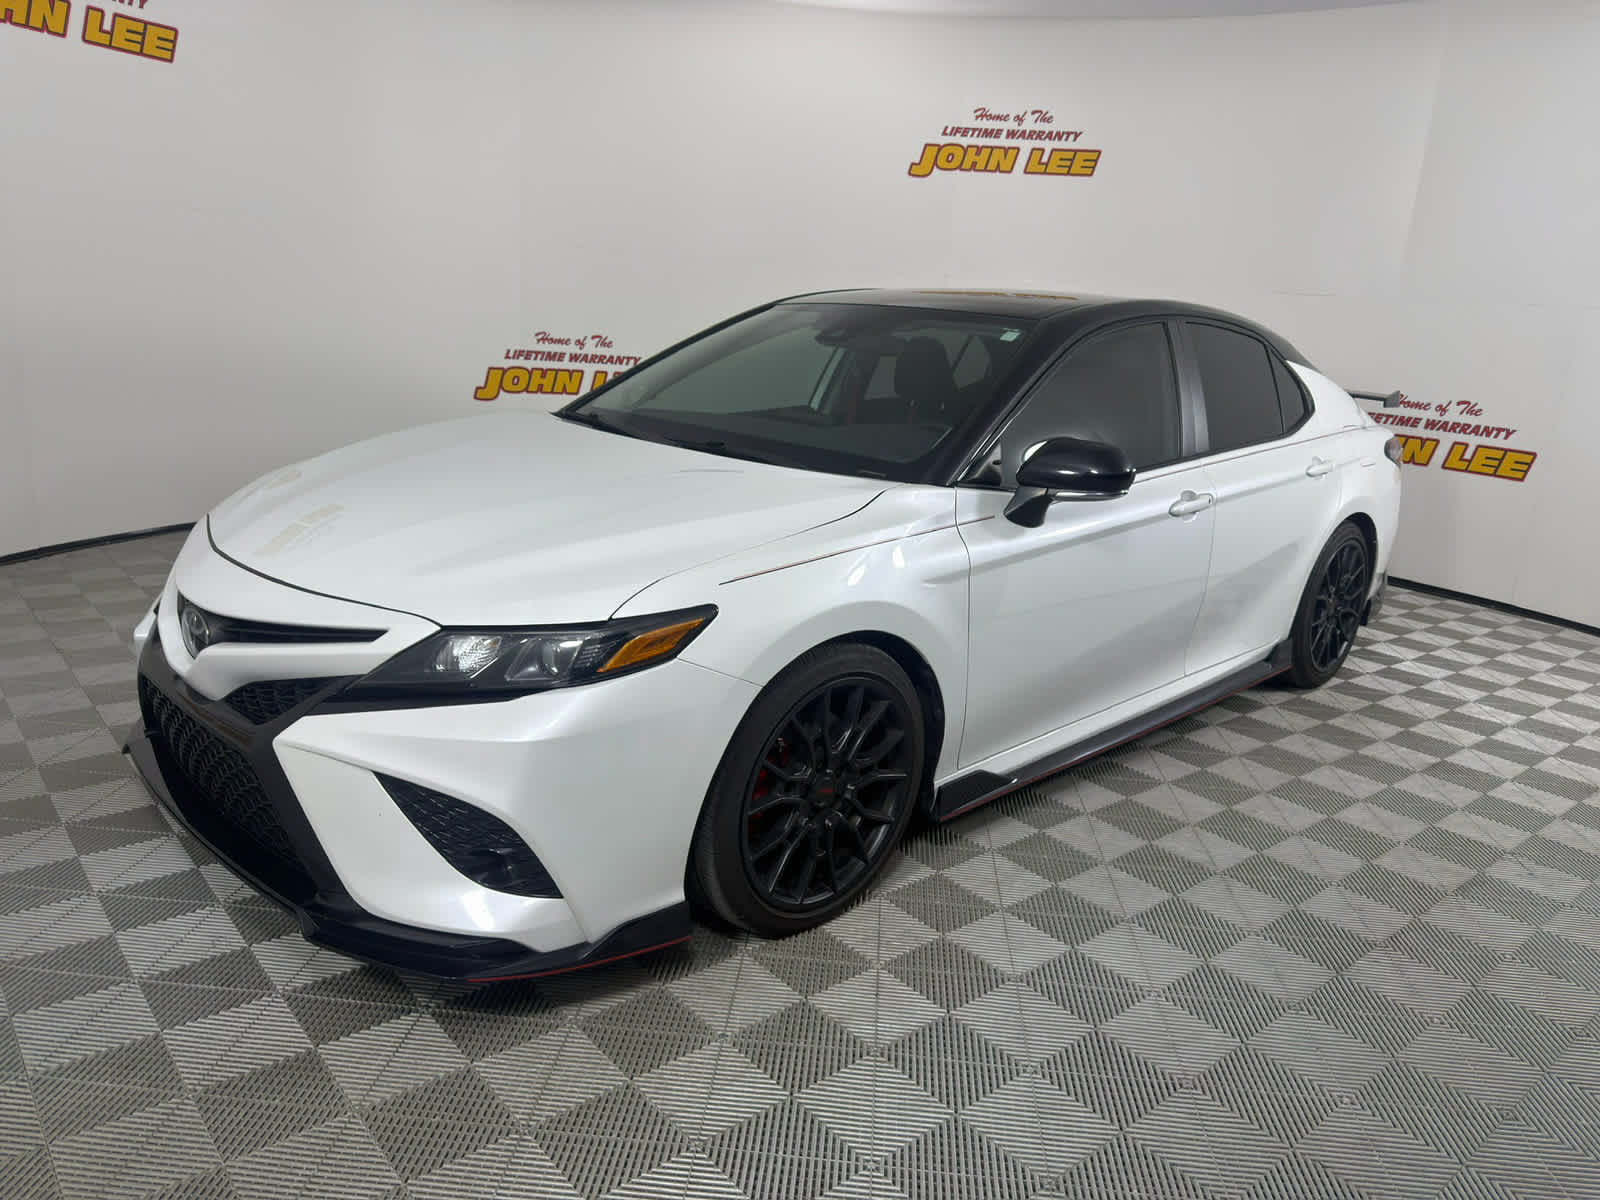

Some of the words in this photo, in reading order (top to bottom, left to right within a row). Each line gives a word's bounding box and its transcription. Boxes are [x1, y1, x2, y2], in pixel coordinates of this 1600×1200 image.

[82, 5, 179, 64] LEE
[973, 107, 1010, 123] Home
[1013, 111, 1026, 126] of
[1031, 109, 1054, 124] The
[941, 126, 1003, 139] LIFETIME
[1005, 128, 1083, 142] WARRANTY
[908, 143, 1020, 178] JOHN
[1024, 148, 1102, 177] LEE
[534, 331, 571, 346] Home
[574, 335, 587, 350] of
[591, 335, 614, 349] The
[504, 349, 567, 362] LIFETIME
[568, 351, 642, 366] WARRANTY
[473, 366, 584, 401] JOHN
[1435, 400, 1451, 417] of
[1456, 400, 1484, 417] The
[1423, 418, 1517, 441] WARRANTY
[1441, 441, 1538, 483] LEE
